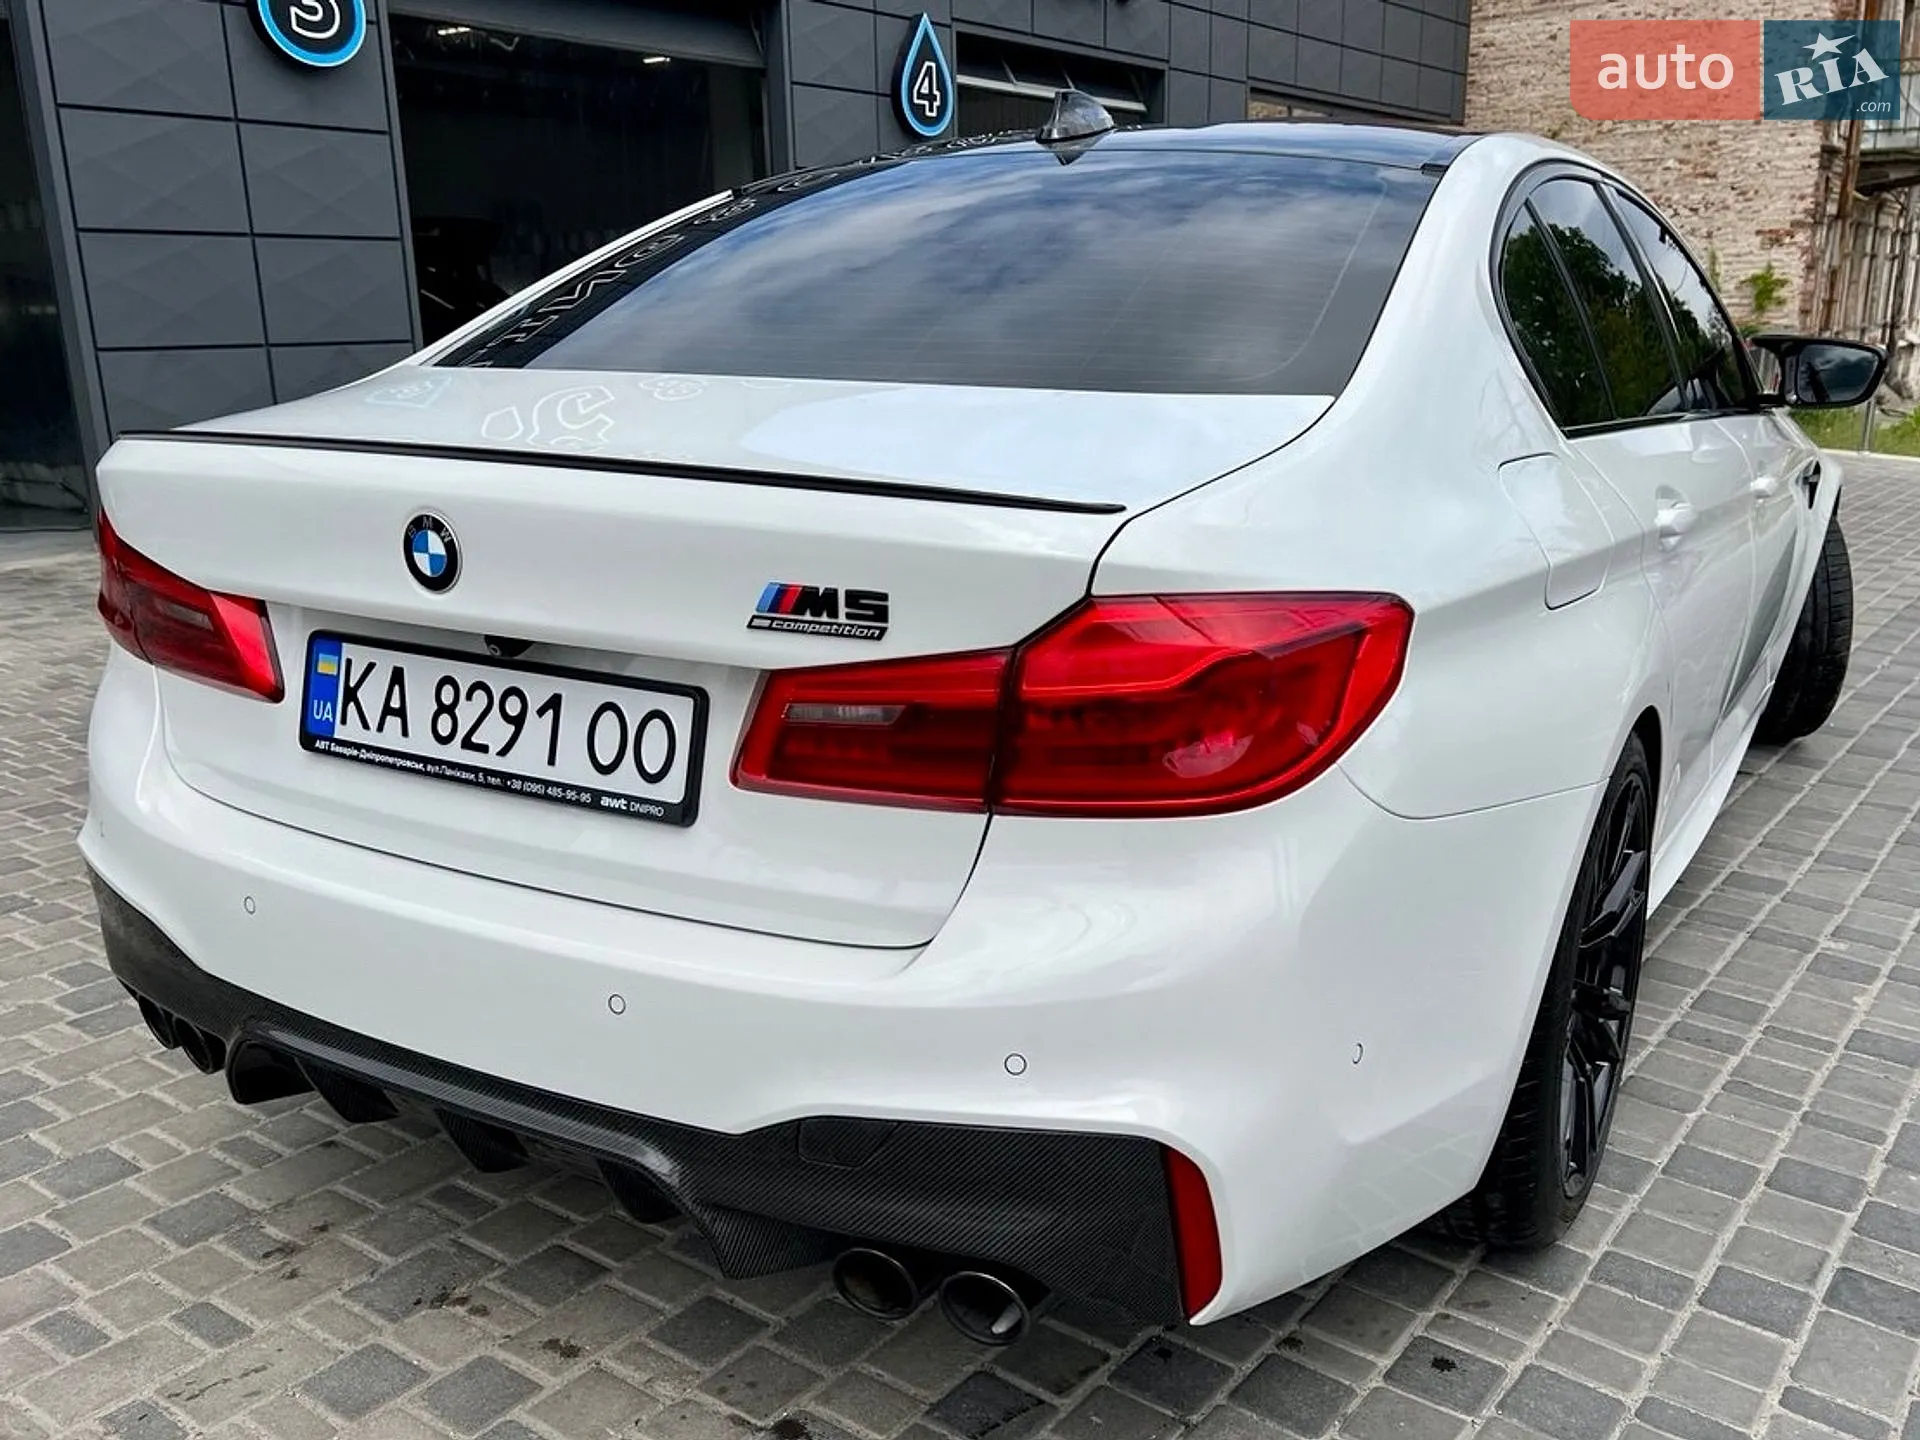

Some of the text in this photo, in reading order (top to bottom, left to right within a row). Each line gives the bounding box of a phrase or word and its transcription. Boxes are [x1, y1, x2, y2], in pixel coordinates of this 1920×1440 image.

[913, 61, 940, 117] 4
[407, 516, 453, 543] BMW
[787, 584, 889, 623] M5
[771, 619, 880, 638] competition
[313, 699, 333, 722] UA
[341, 658, 409, 738] KA
[430, 675, 563, 767] 8291
[600, 796, 665, 817] awt DNIPRO
